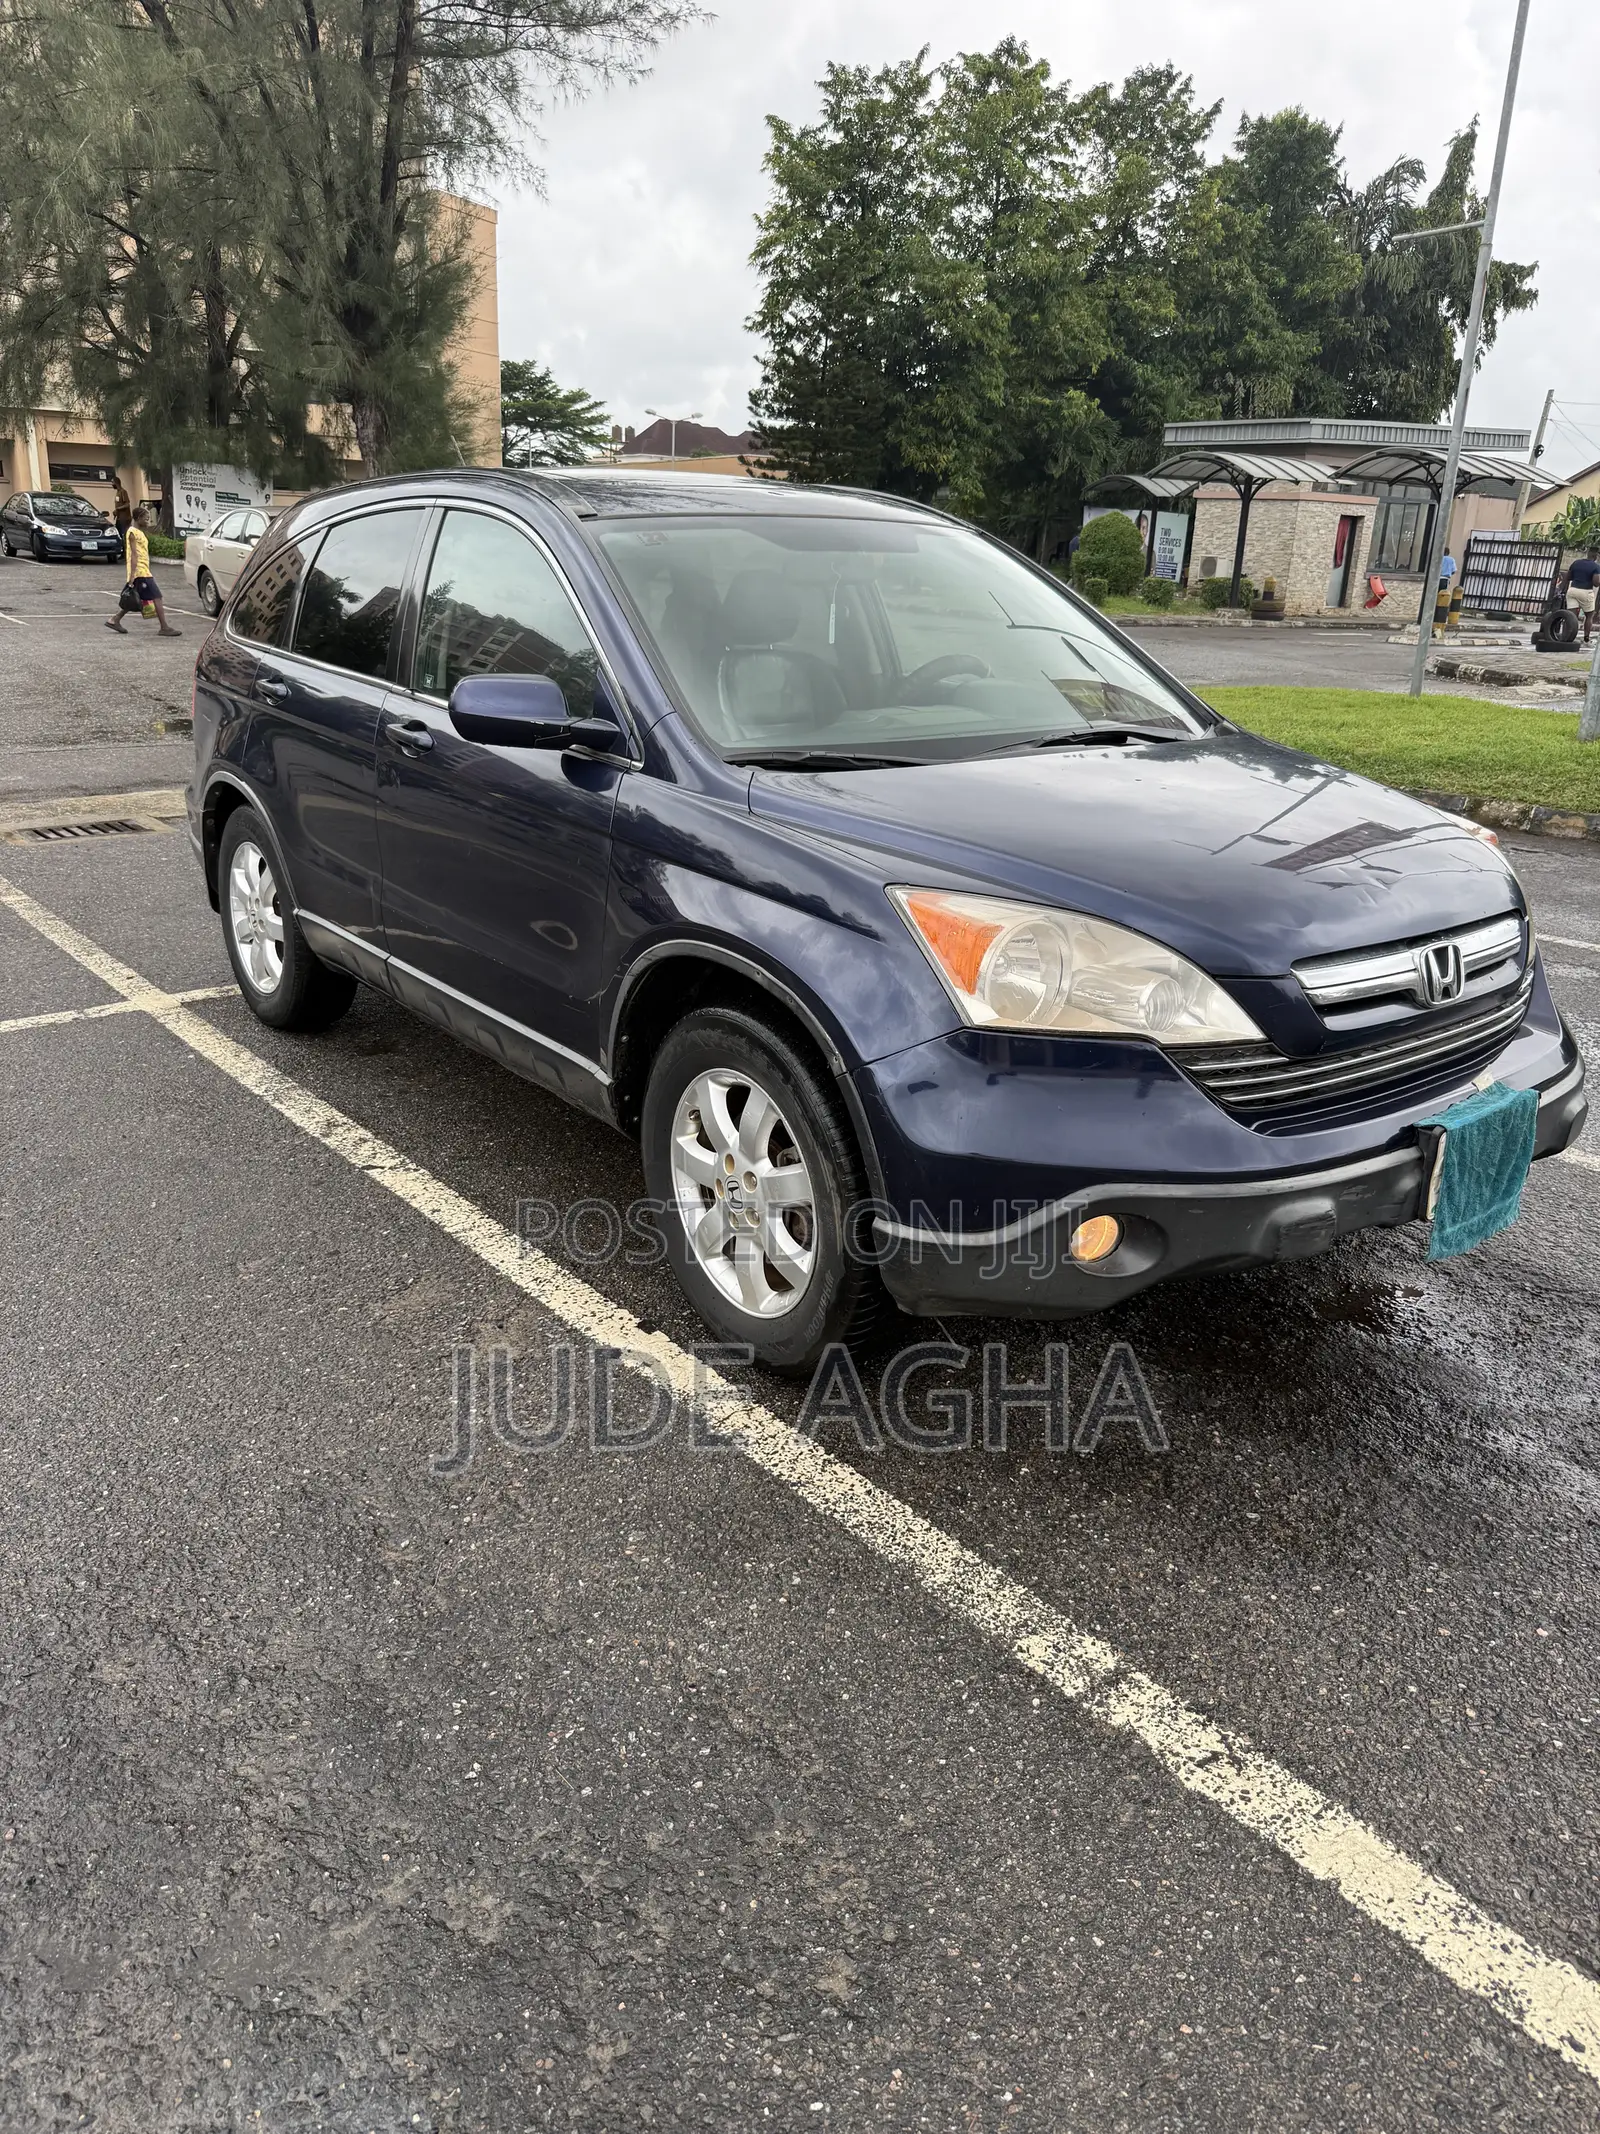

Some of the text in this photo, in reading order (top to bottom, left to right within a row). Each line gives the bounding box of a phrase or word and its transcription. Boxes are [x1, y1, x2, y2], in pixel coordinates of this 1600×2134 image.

[180, 466, 207, 476] Unlock
[180, 474, 216, 484] Potential
[1161, 528, 1171, 537] TWO
[1159, 537, 1181, 547] SERVICES
